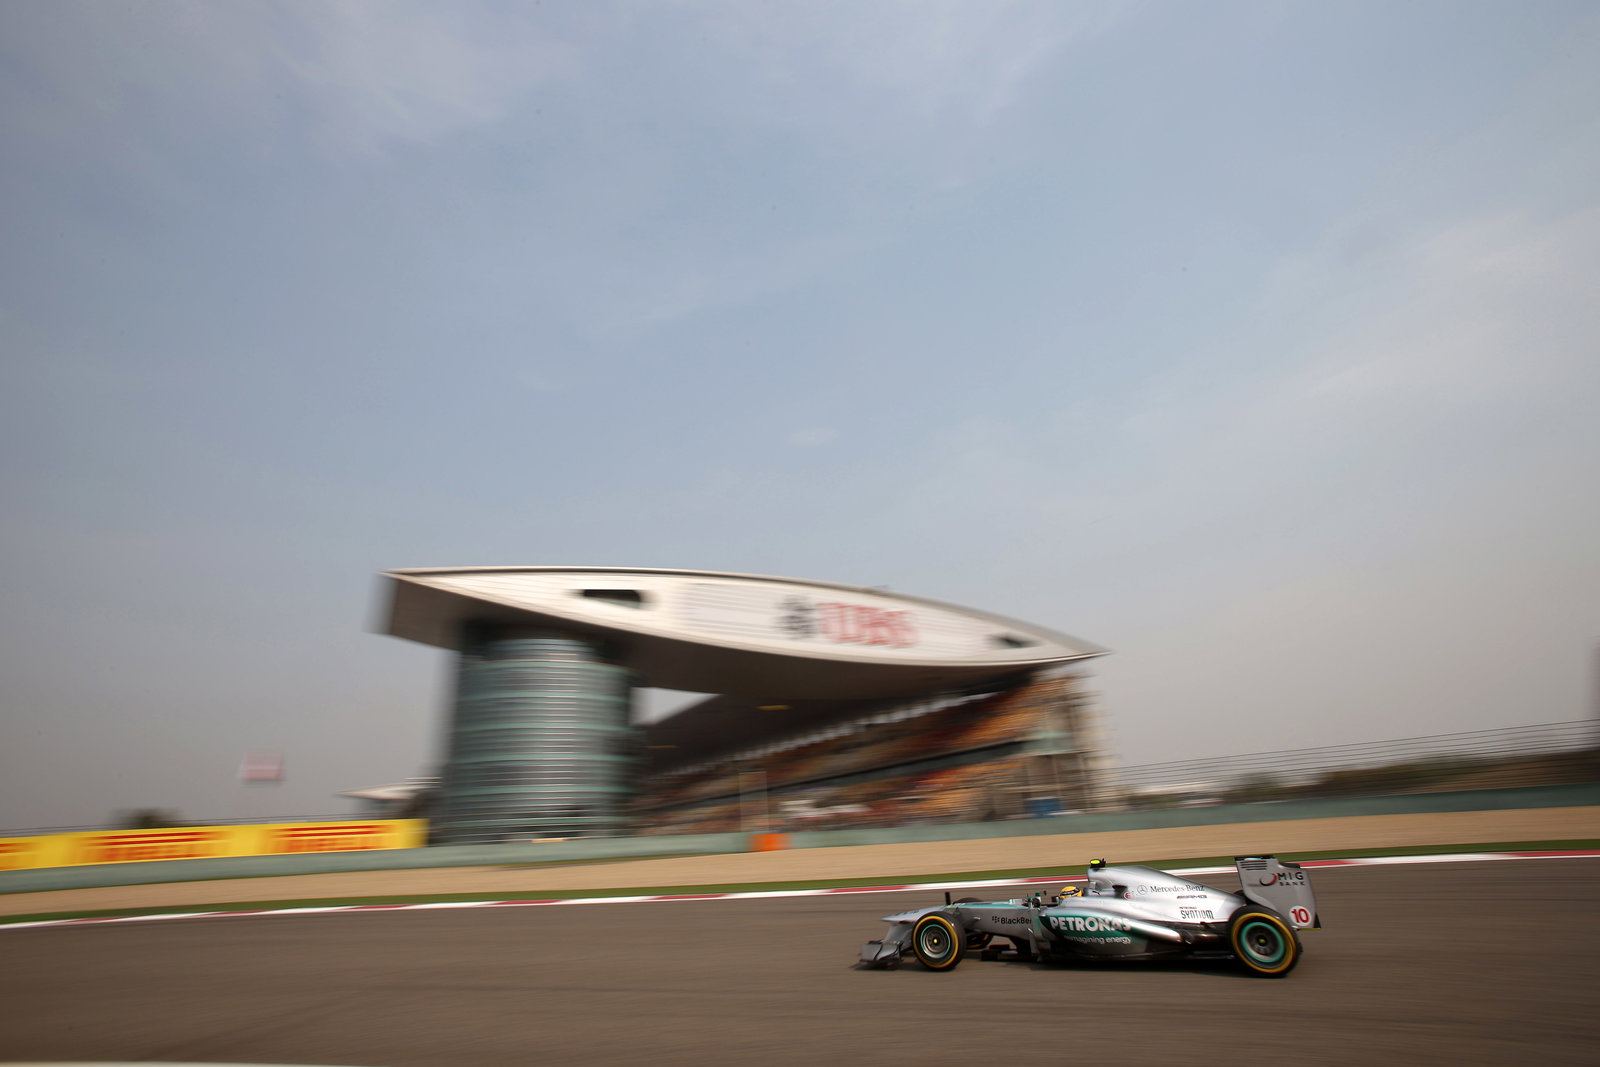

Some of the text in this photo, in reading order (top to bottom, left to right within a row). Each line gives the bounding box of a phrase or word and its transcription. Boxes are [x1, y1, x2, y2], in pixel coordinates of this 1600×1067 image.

[1291, 908, 1309, 923] 10
[1049, 916, 1131, 932] PETRONAS
[1105, 936, 1131, 945] energy
